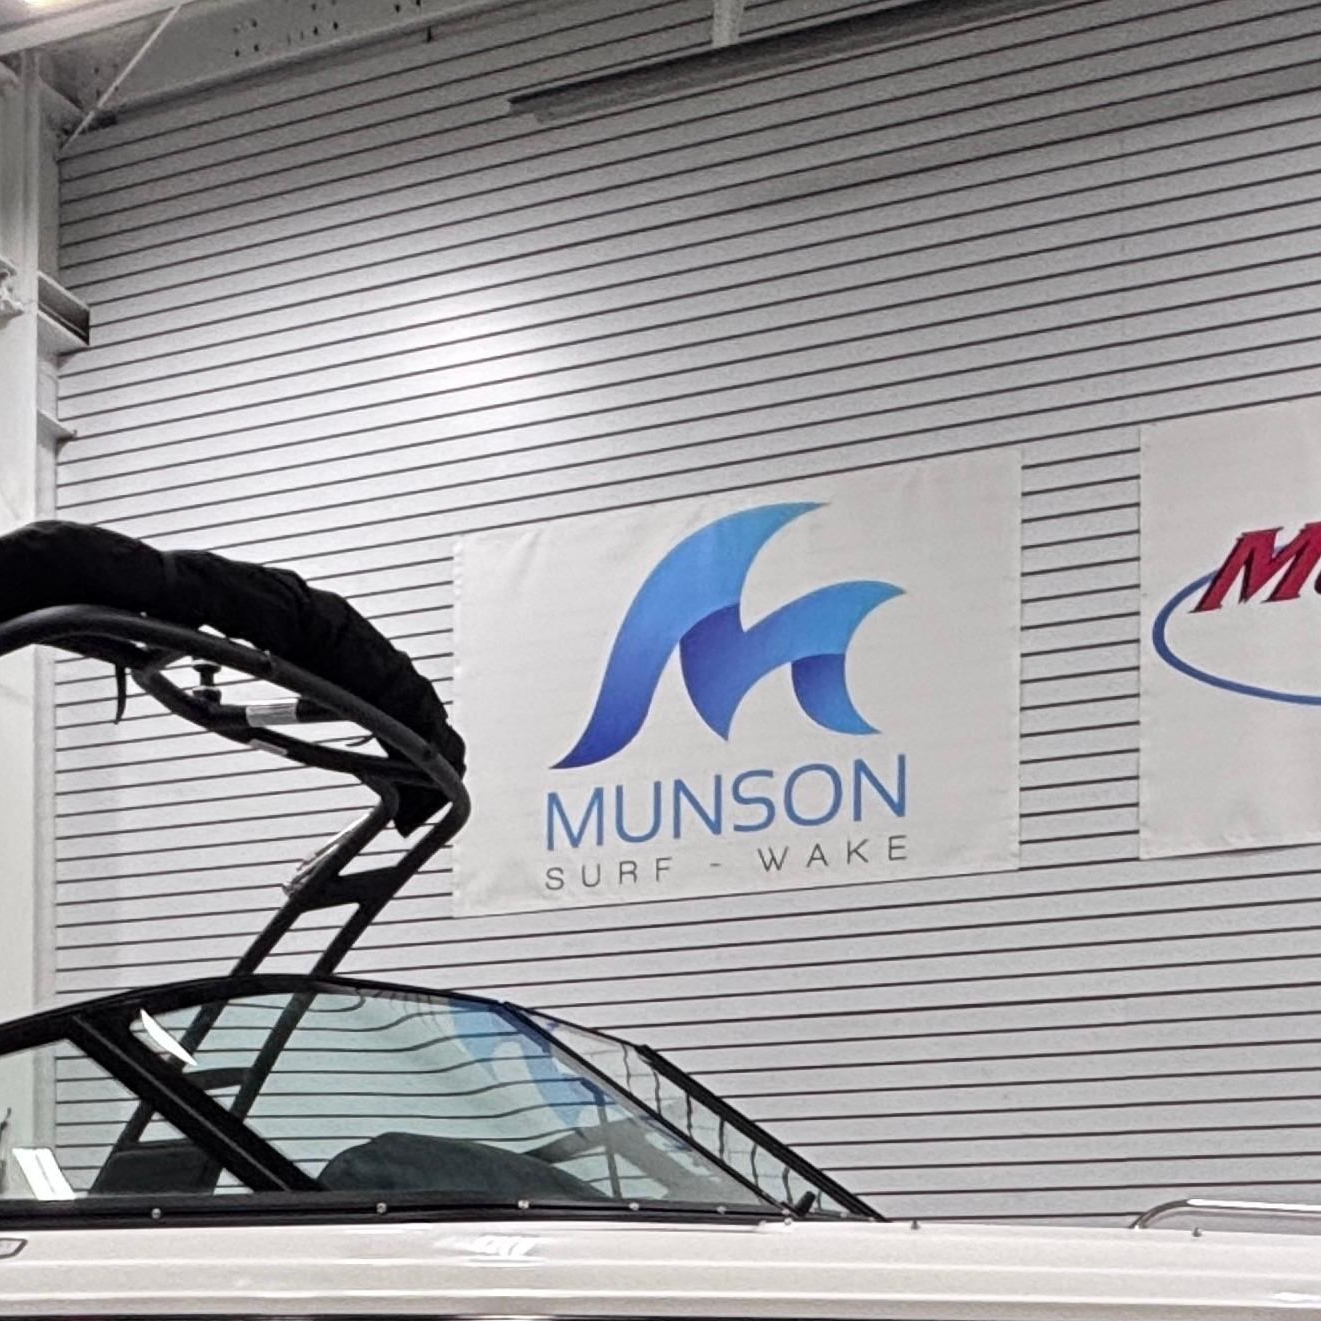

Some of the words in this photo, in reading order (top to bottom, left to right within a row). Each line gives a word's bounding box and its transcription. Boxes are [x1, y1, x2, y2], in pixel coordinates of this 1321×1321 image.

[546, 753, 907, 852] MUNSON
[545, 856, 674, 892] SURF
[757, 834, 908, 873] WAKE
